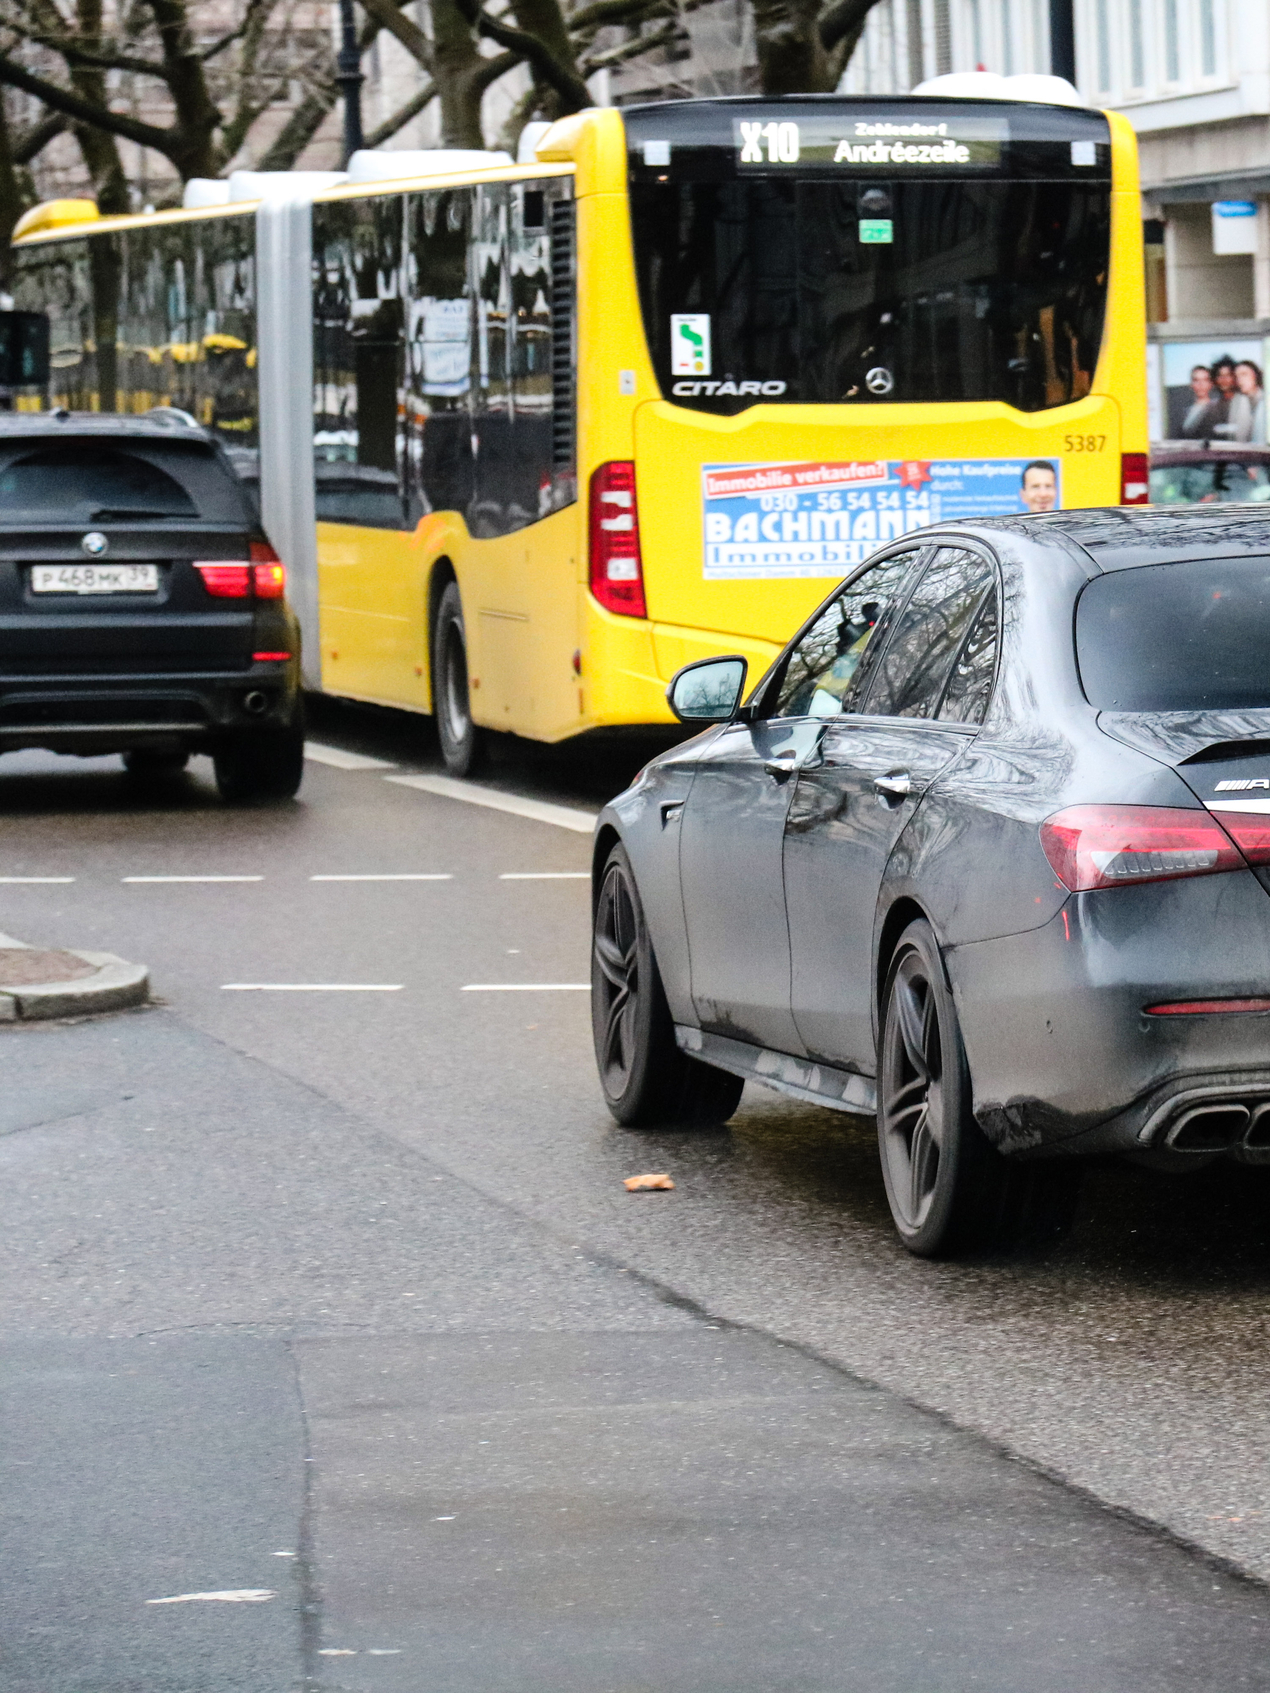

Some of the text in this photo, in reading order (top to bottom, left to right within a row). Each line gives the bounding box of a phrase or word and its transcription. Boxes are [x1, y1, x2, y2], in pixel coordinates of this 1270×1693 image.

[740, 122, 799, 163] X10
[834, 140, 970, 163] Andréezeile
[672, 380, 787, 396] CITARO
[1065, 434, 1106, 452] 5387
[707, 471, 792, 494] Immobilie
[796, 462, 886, 486] verkaufen?
[962, 463, 1022, 479] Kaufpreise
[760, 493, 798, 511] 030
[817, 492, 842, 511] 56
[847, 491, 871, 510] 54
[876, 491, 900, 509] 54
[905, 491, 929, 509] 54
